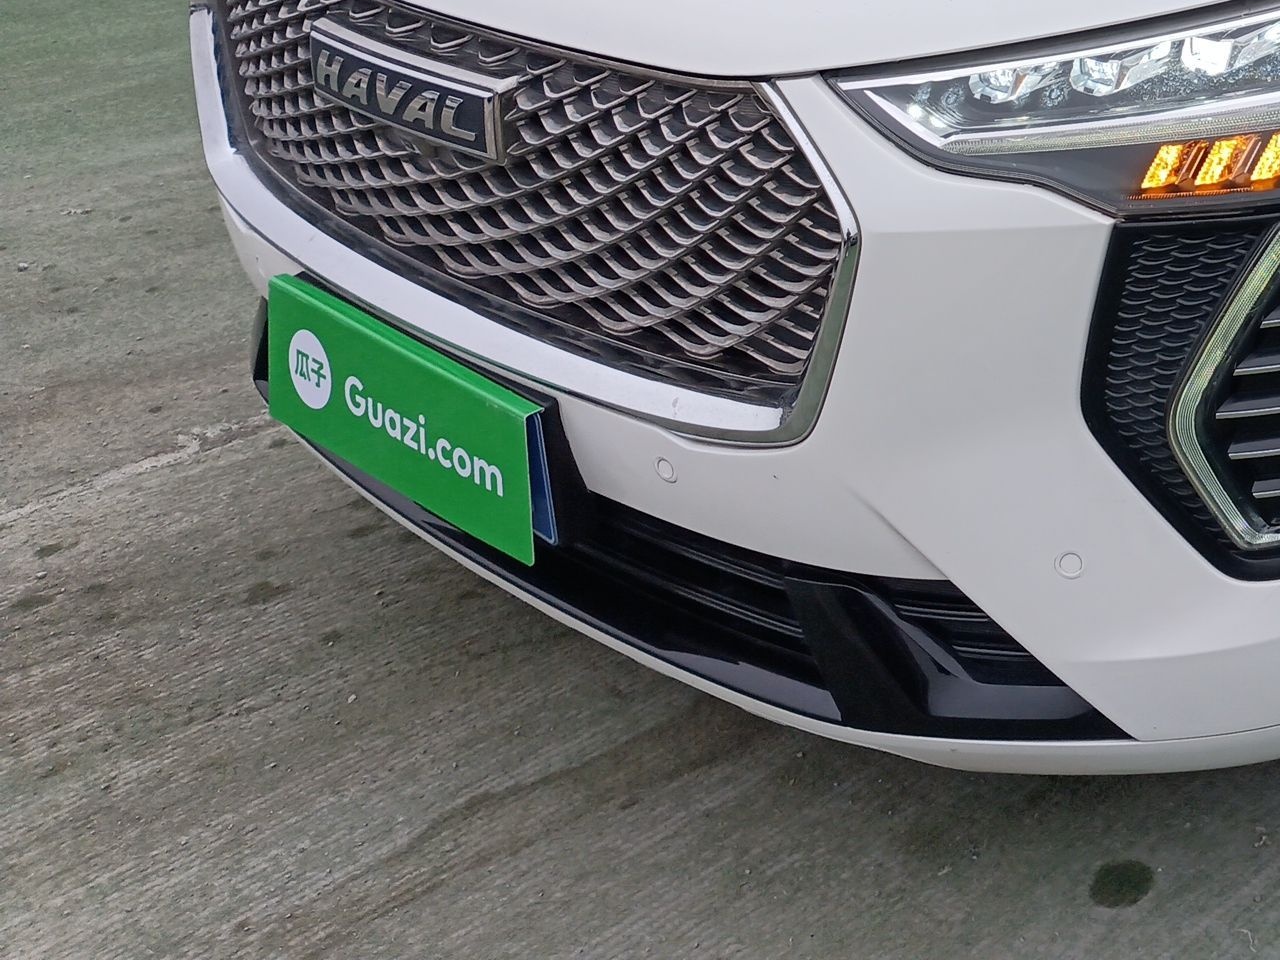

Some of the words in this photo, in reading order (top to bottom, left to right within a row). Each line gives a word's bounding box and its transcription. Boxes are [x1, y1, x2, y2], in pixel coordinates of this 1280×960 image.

[316, 49, 477, 141] HAVAL
[294, 348, 327, 388] 瓜子
[344, 375, 504, 497] Guazi.com
